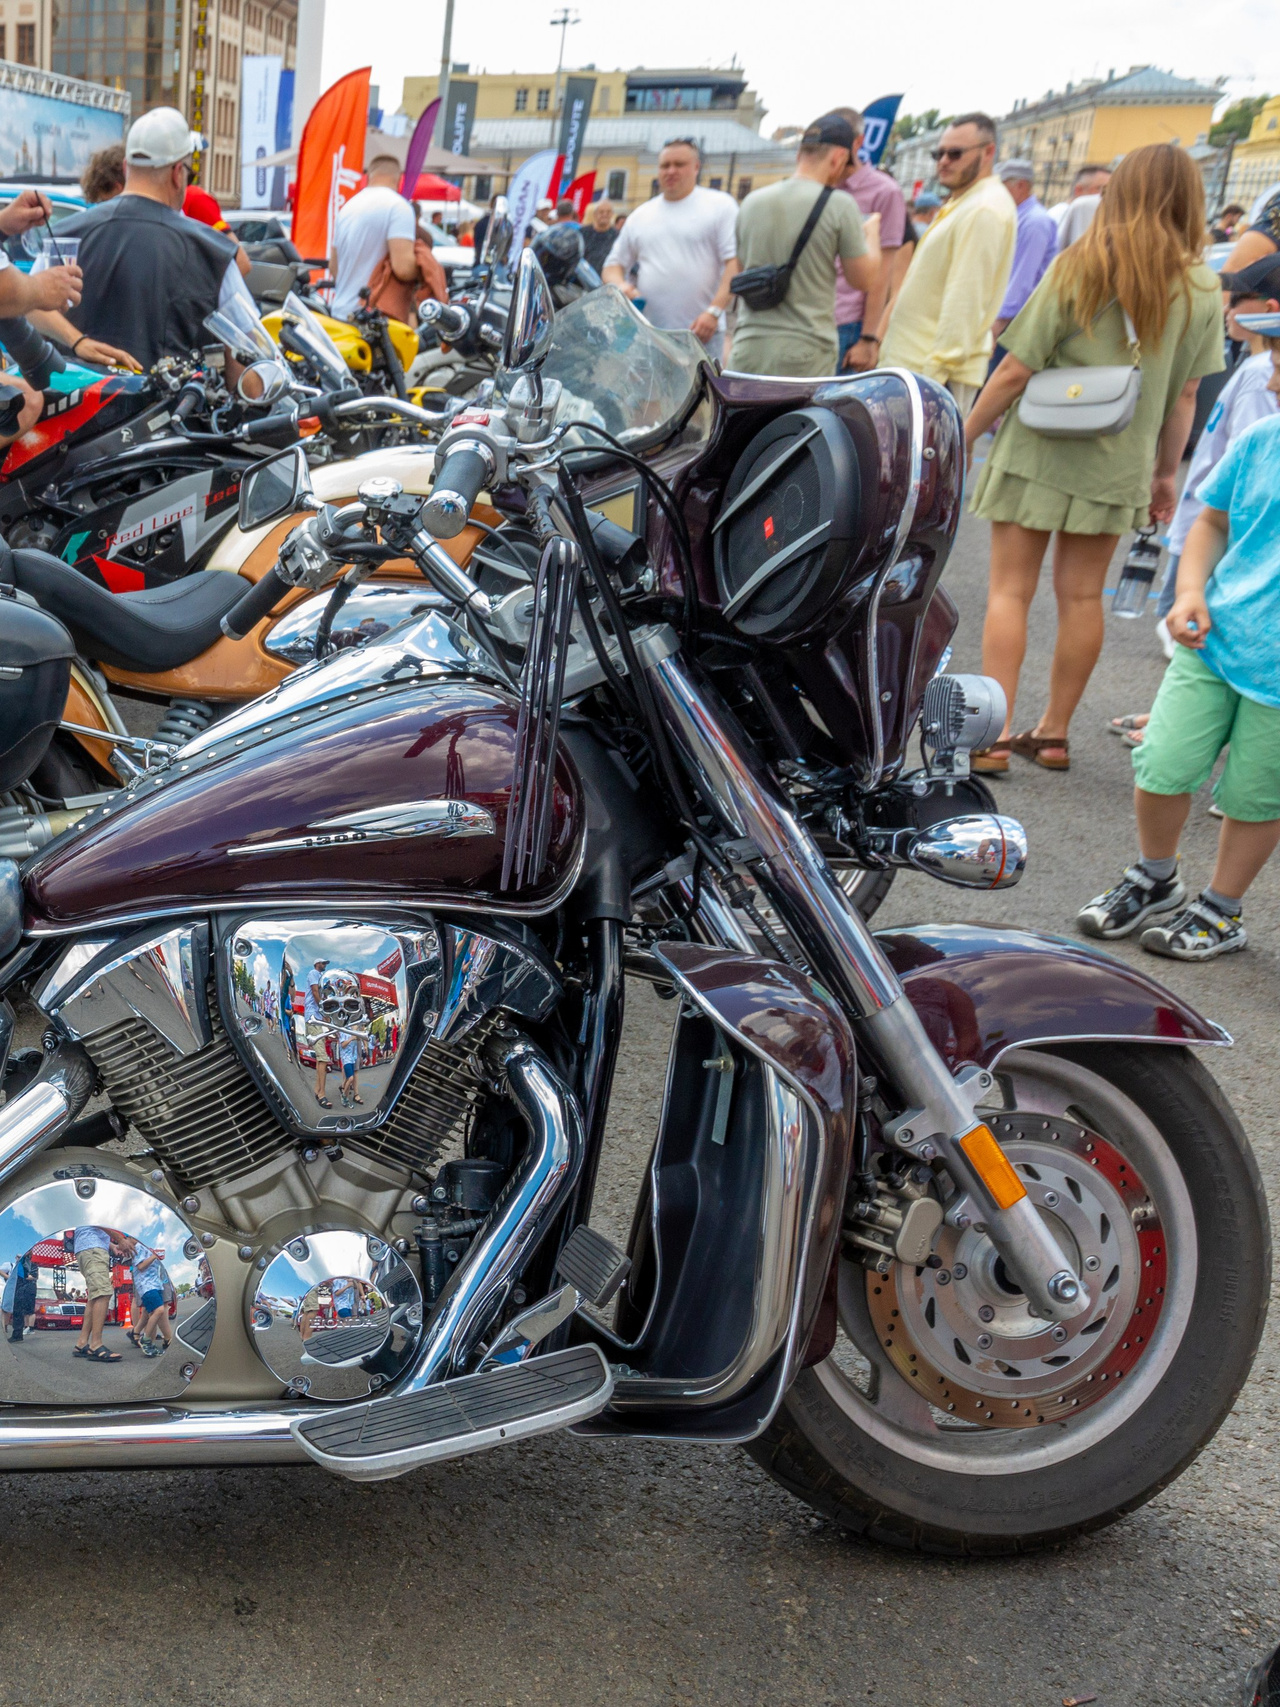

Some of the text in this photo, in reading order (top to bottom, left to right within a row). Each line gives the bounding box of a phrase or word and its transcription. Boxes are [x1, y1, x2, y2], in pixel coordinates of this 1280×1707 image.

[452, 102, 468, 155] OLUTE
[105, 483, 241, 550] Red Line Tea
[303, 833, 367, 847] 1300
[1222, 1267, 1240, 1323] TUBELESS
[309, 1318, 378, 1329] HONDA
